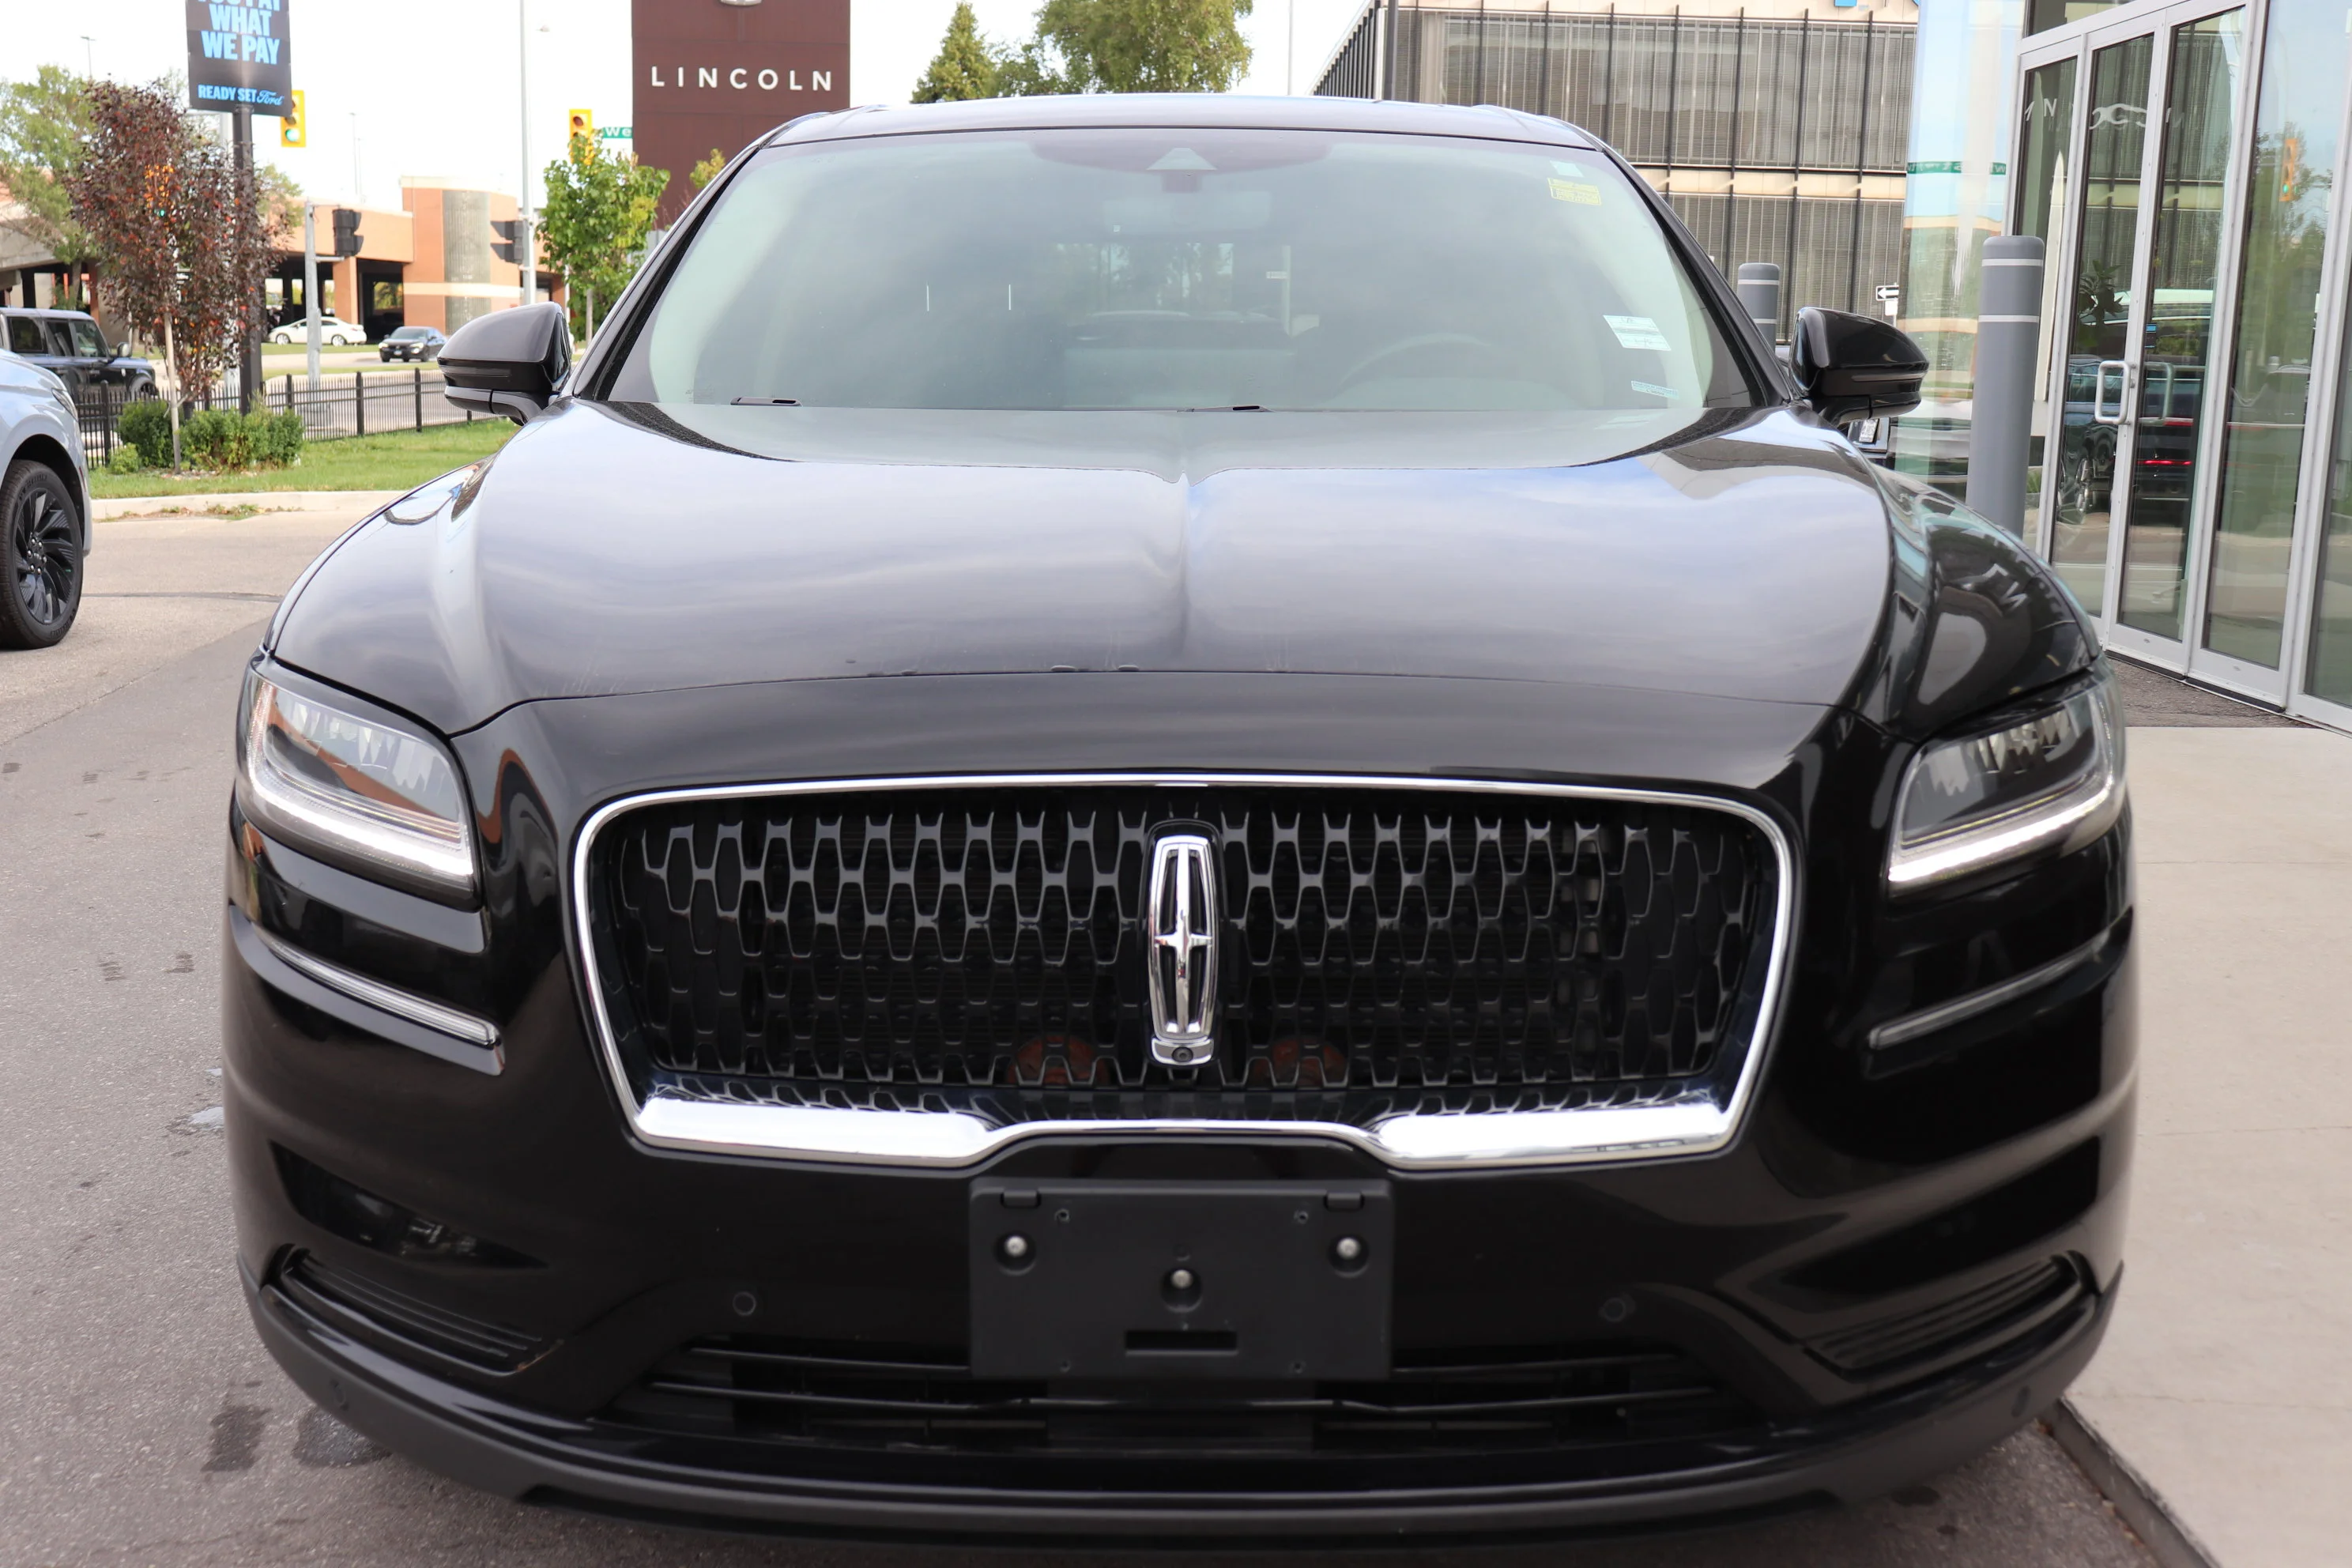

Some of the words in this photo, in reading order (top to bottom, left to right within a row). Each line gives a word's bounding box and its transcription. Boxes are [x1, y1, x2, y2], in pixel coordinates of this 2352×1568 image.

[209, 3, 272, 36] WHAT
[201, 30, 238, 60] WE
[242, 34, 281, 65] PAY
[651, 66, 831, 91] LINCOLN
[198, 84, 236, 101] READY
[237, 88, 257, 103] SET
[257, 90, 285, 106] Ford
